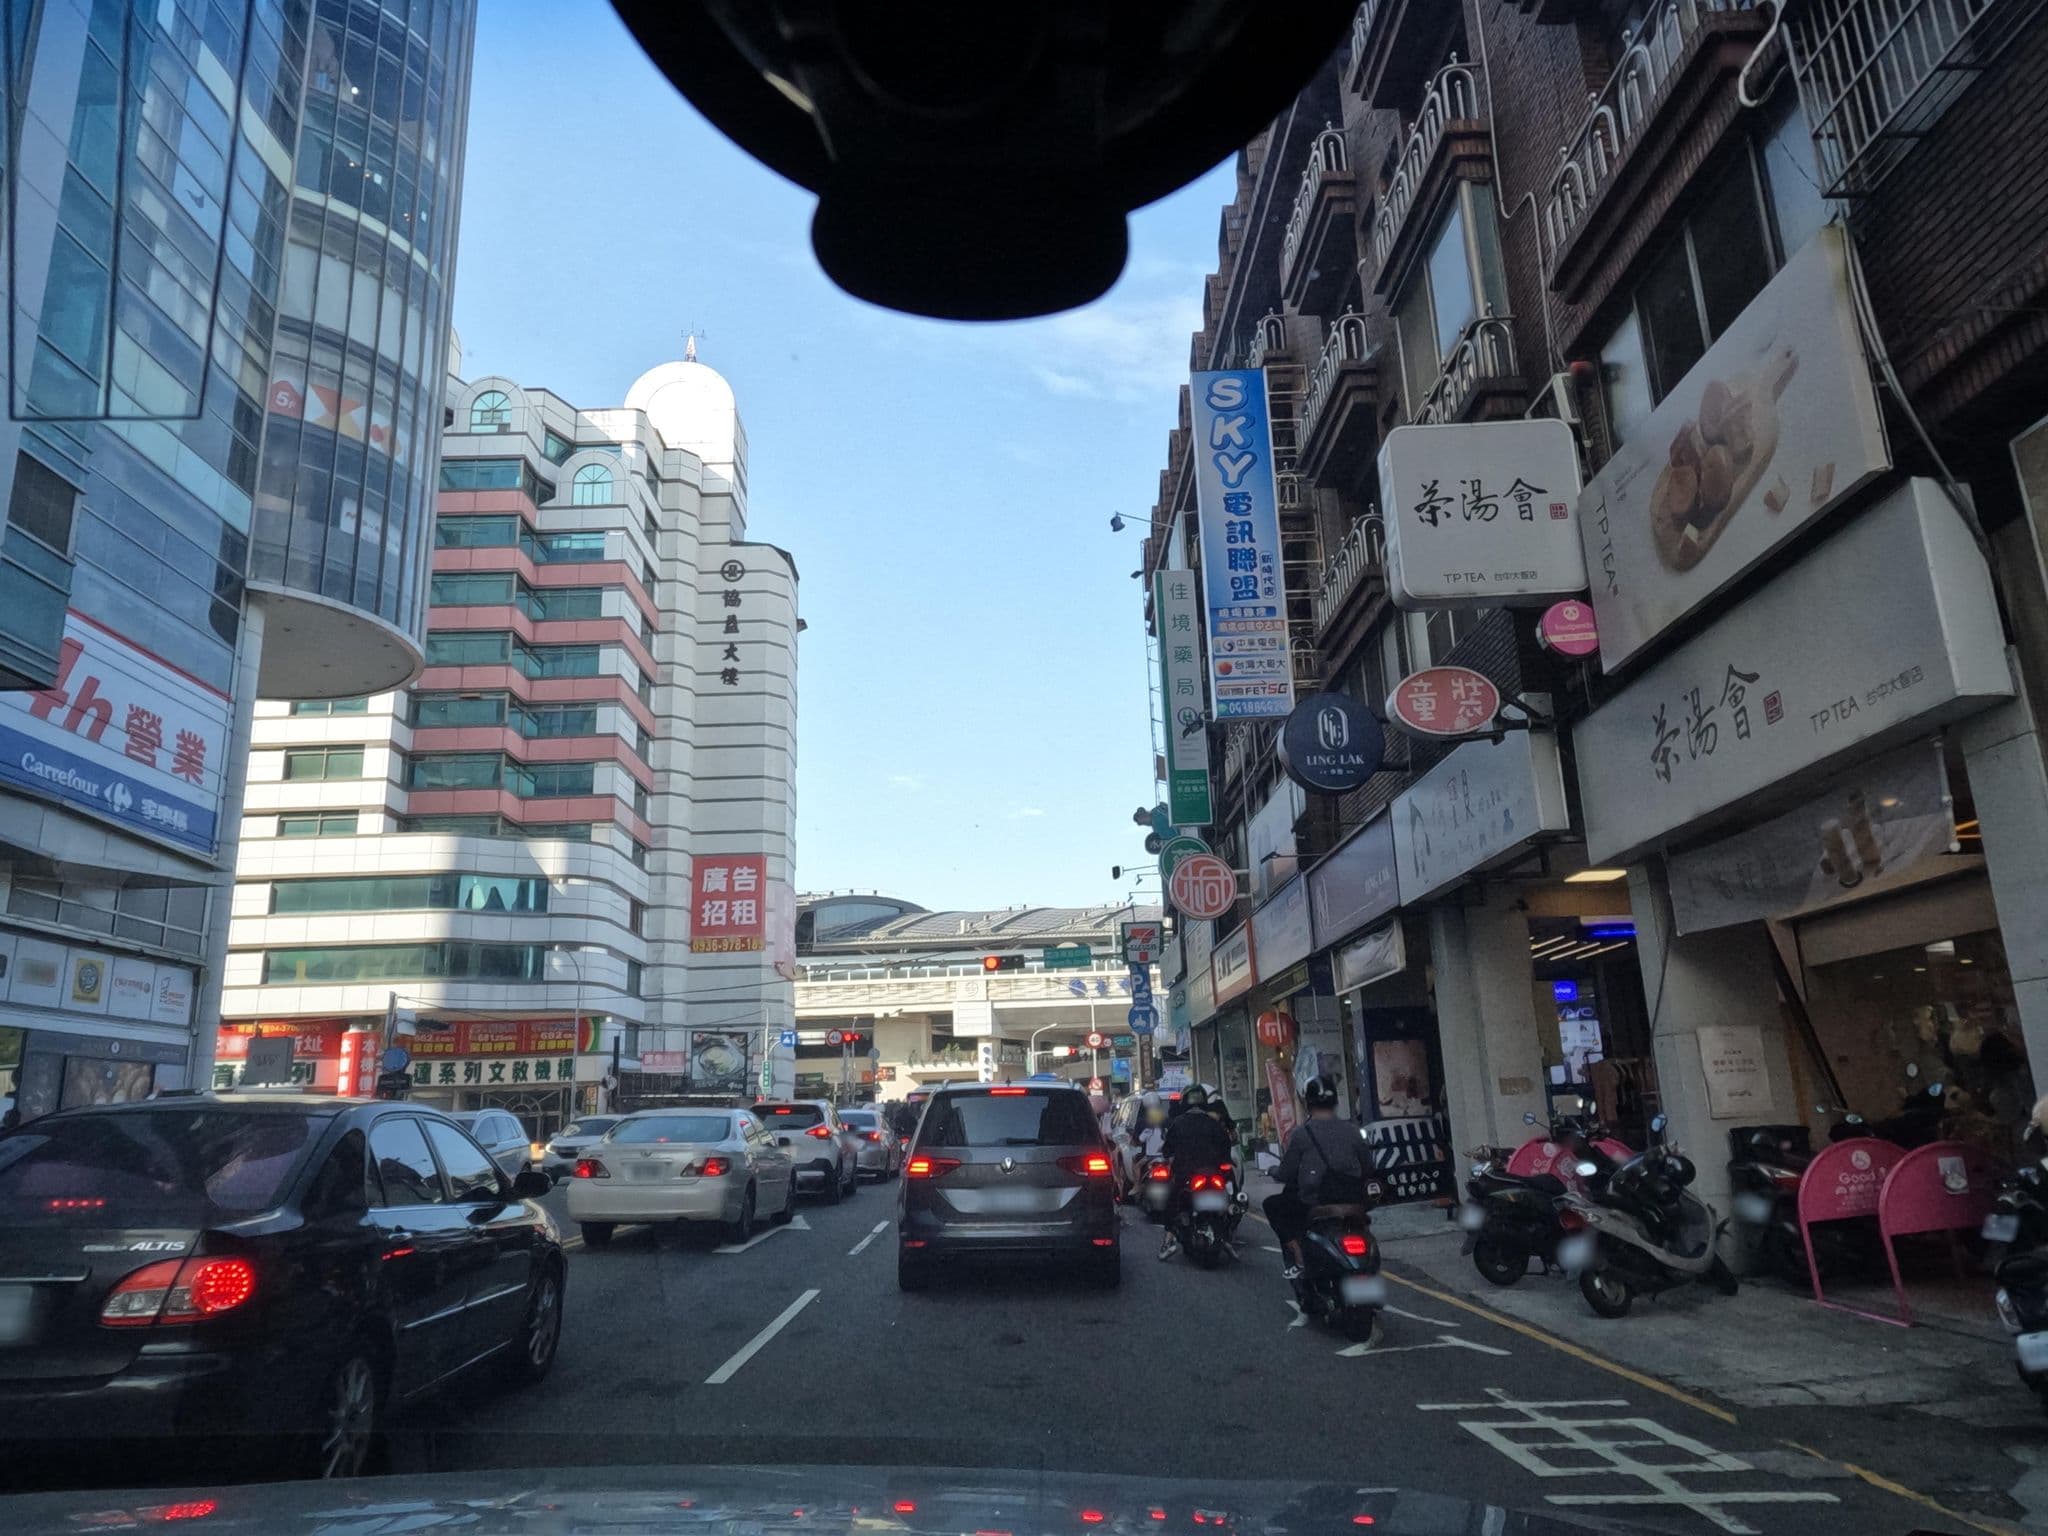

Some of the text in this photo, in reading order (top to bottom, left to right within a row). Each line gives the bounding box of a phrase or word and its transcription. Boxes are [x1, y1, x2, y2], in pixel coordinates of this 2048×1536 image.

[1207, 378, 1258, 488] SKY
[1413, 477, 1548, 529] 茶湯會
[1223, 491, 1260, 602] 電訊聯盟
[1169, 581, 1196, 697] 佳境藥局
[1234, 659, 1287, 670] 台灣大哥大
[1407, 676, 1485, 730] 童裝
[1650, 663, 1760, 784] 茶湯會
[21, 752, 99, 798] Carrefour
[1306, 753, 1365, 766] LING LAK
[702, 866, 758, 893] 廣告
[701, 899, 757, 926] 招租
[129, 1240, 186, 1252] ALTIS
